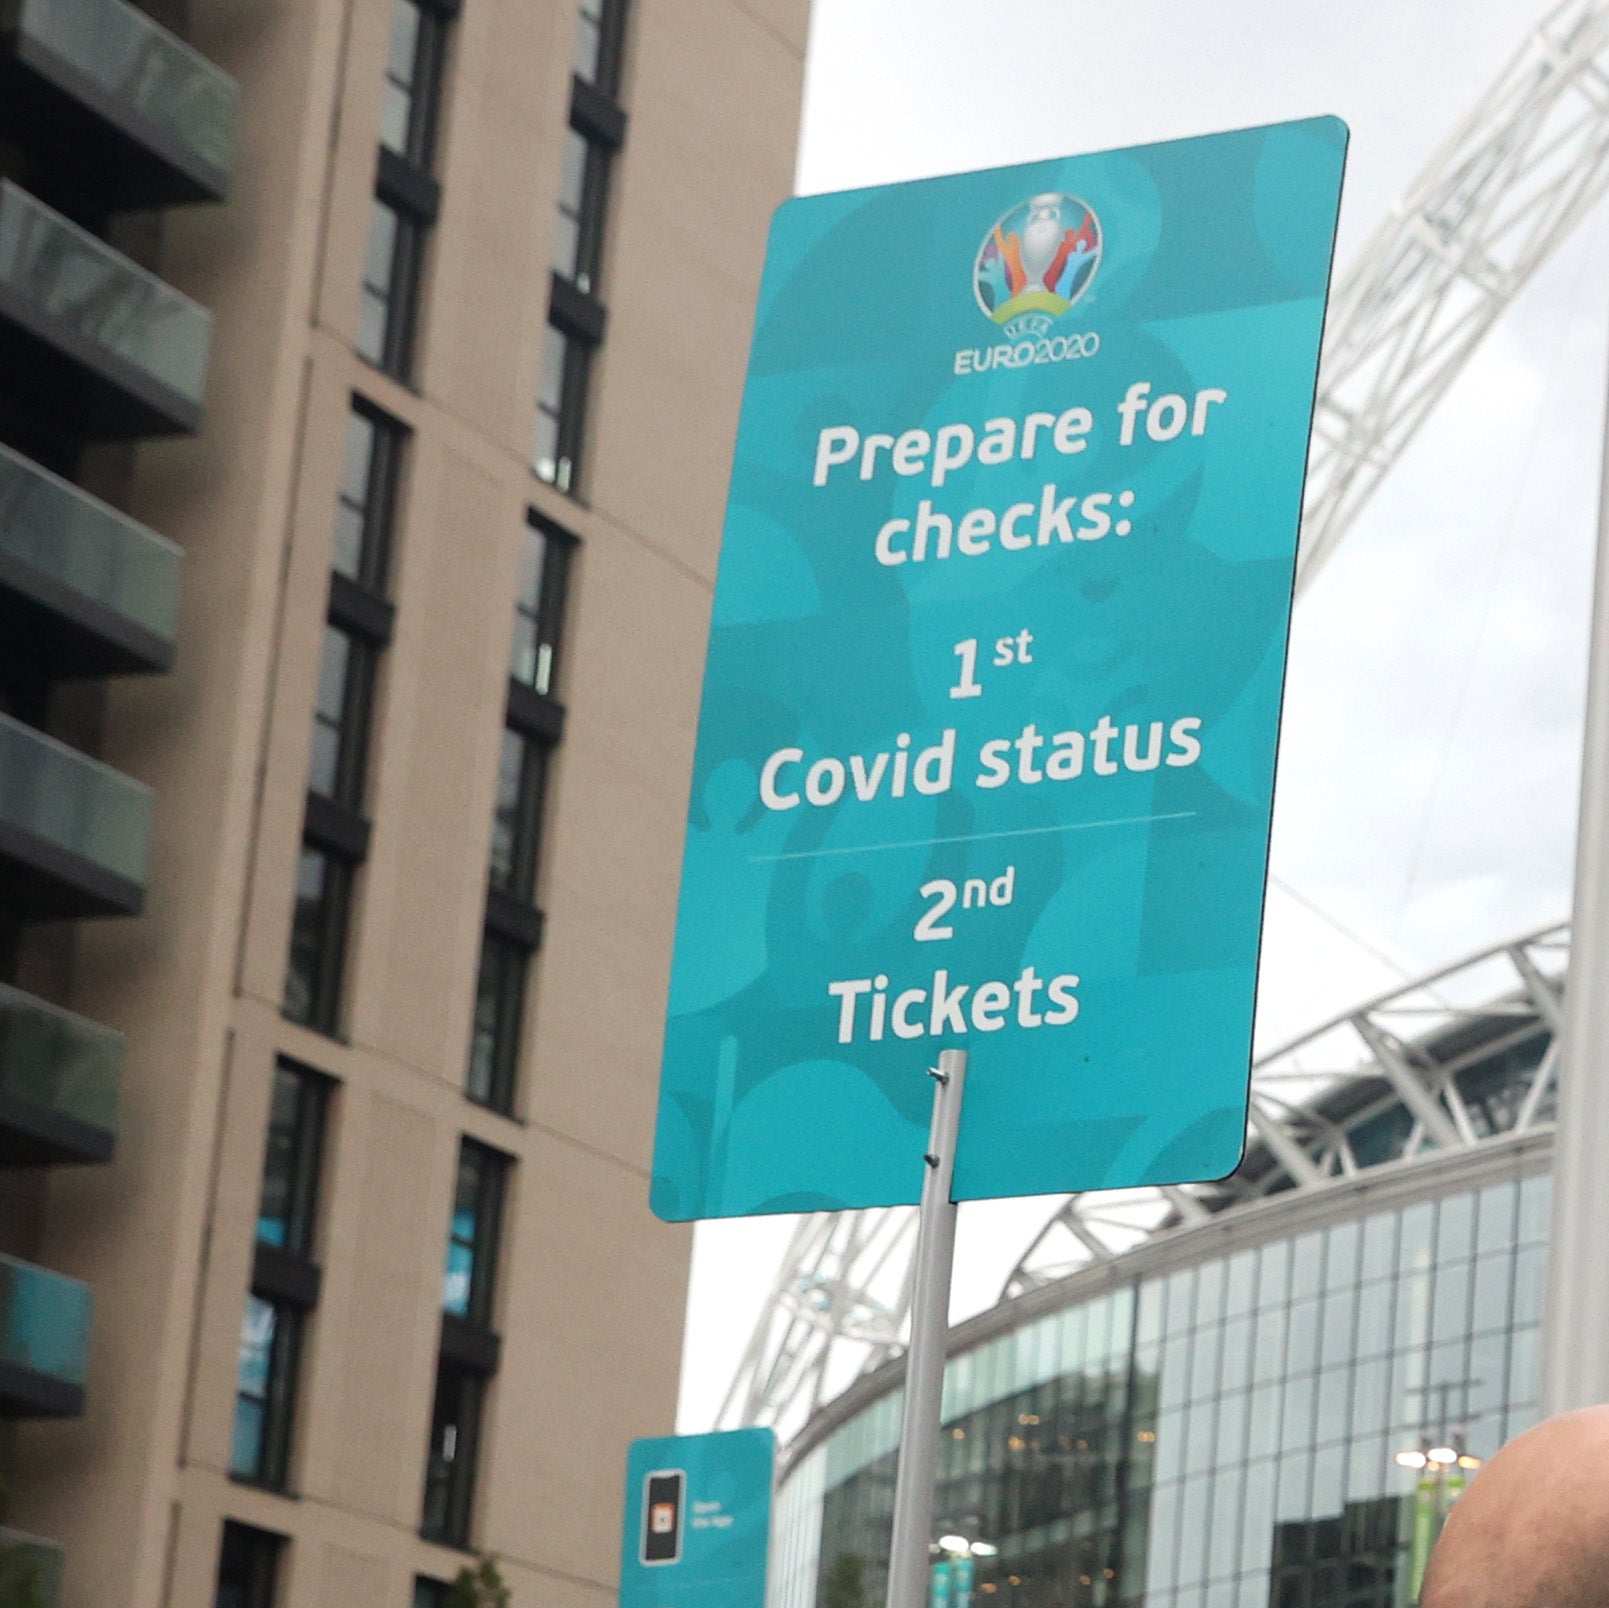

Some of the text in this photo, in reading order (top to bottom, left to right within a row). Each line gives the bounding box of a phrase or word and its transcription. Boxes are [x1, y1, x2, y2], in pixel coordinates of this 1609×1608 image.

[953, 331, 1101, 376] EURO2020
[1003, 313, 1054, 341] UEFA
[812, 382, 1228, 488] Prepare for
[874, 482, 1135, 567] checks:
[759, 715, 1204, 812] Covid status
[912, 865, 1016, 943] 2nd
[827, 965, 1081, 1045] Tickets
